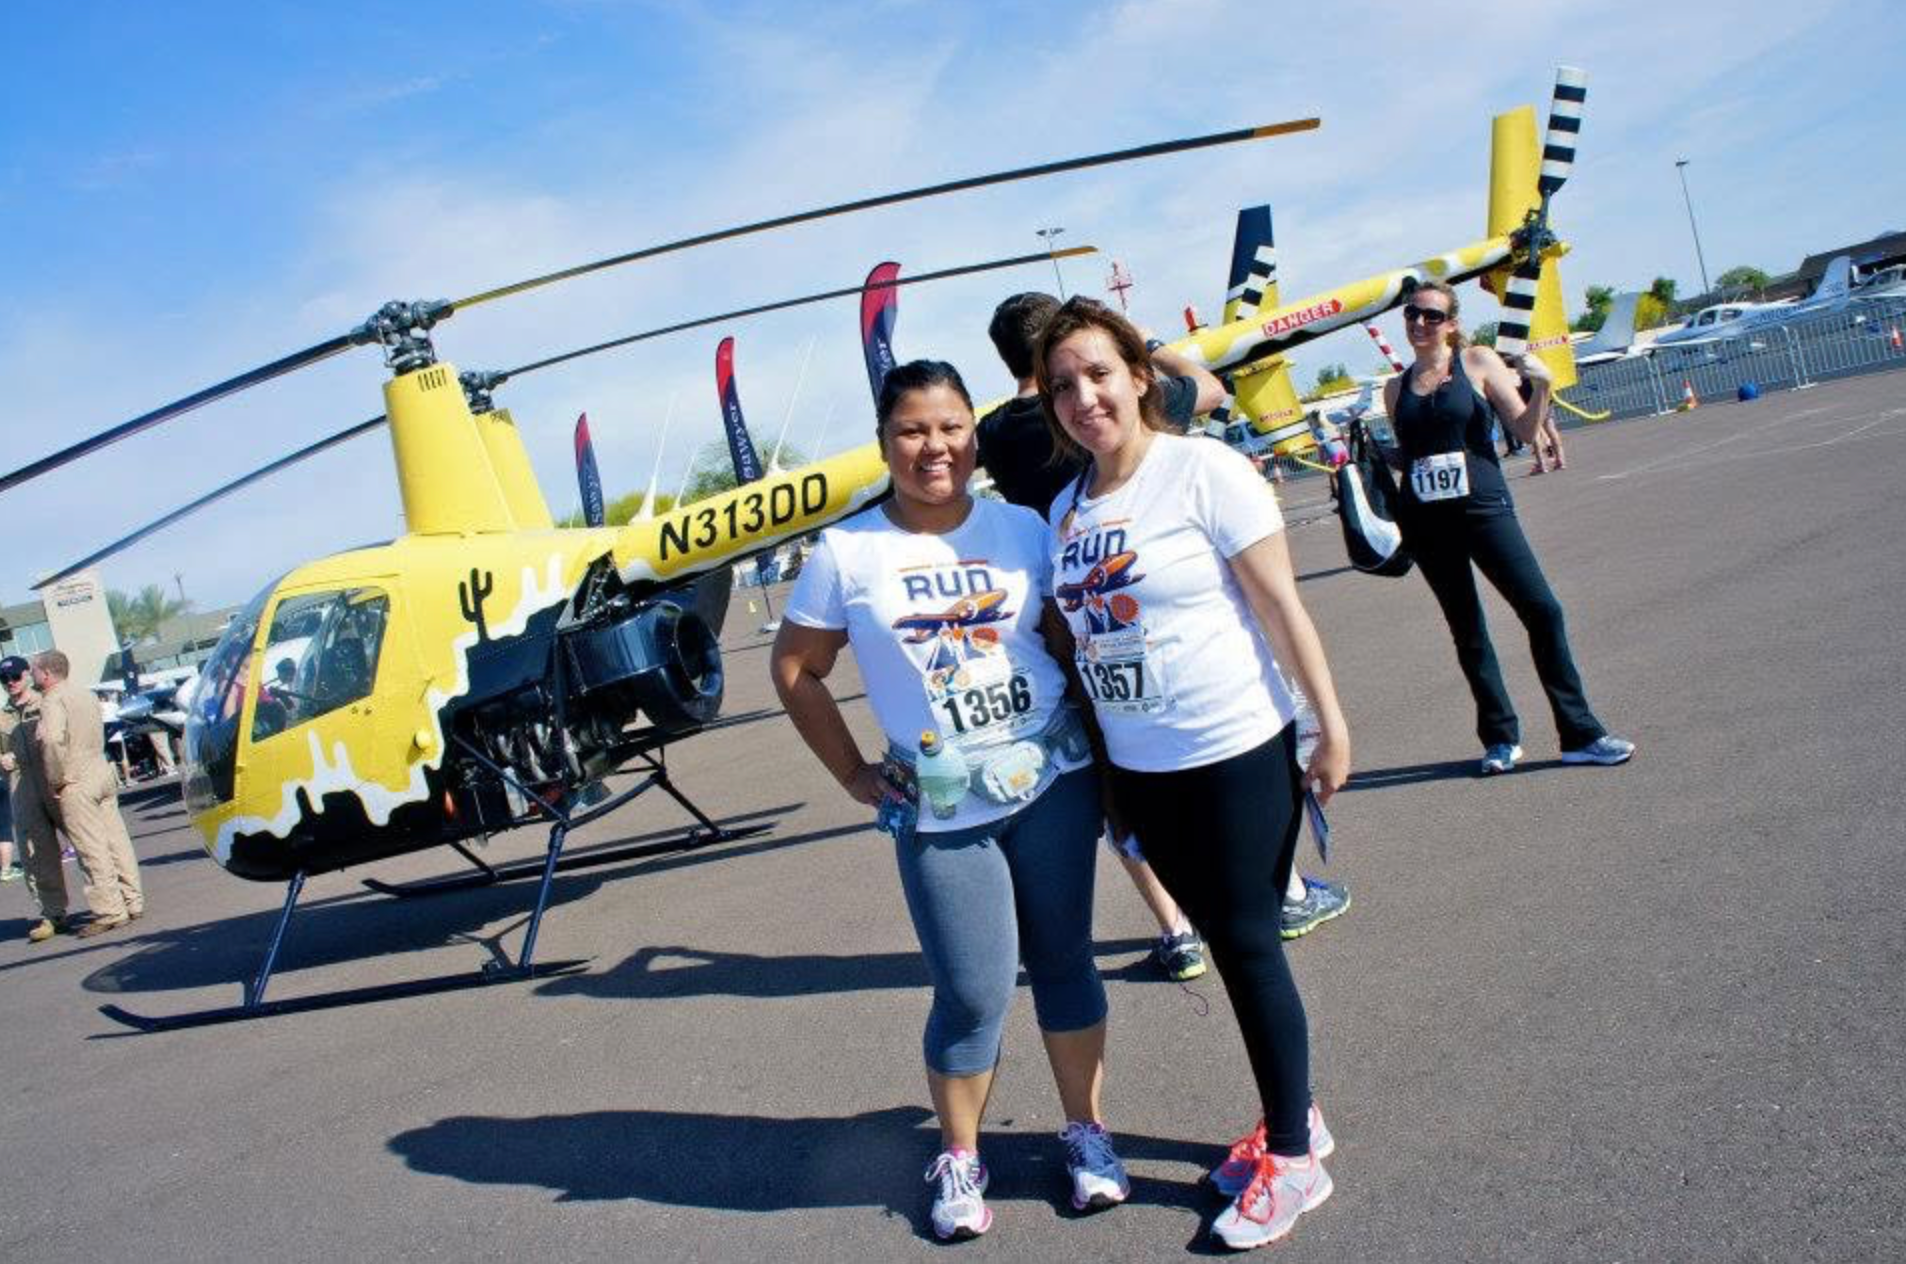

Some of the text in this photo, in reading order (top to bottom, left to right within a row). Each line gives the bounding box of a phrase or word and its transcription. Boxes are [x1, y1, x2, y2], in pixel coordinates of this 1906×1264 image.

[1264, 302, 1333, 339] DANGER
[1415, 467, 1461, 493] 1197
[660, 486, 827, 561] N313DD
[1062, 529, 1126, 571] RUN
[902, 569, 993, 601] RUN
[1082, 662, 1143, 700] 1357
[942, 675, 1031, 733] 1356
